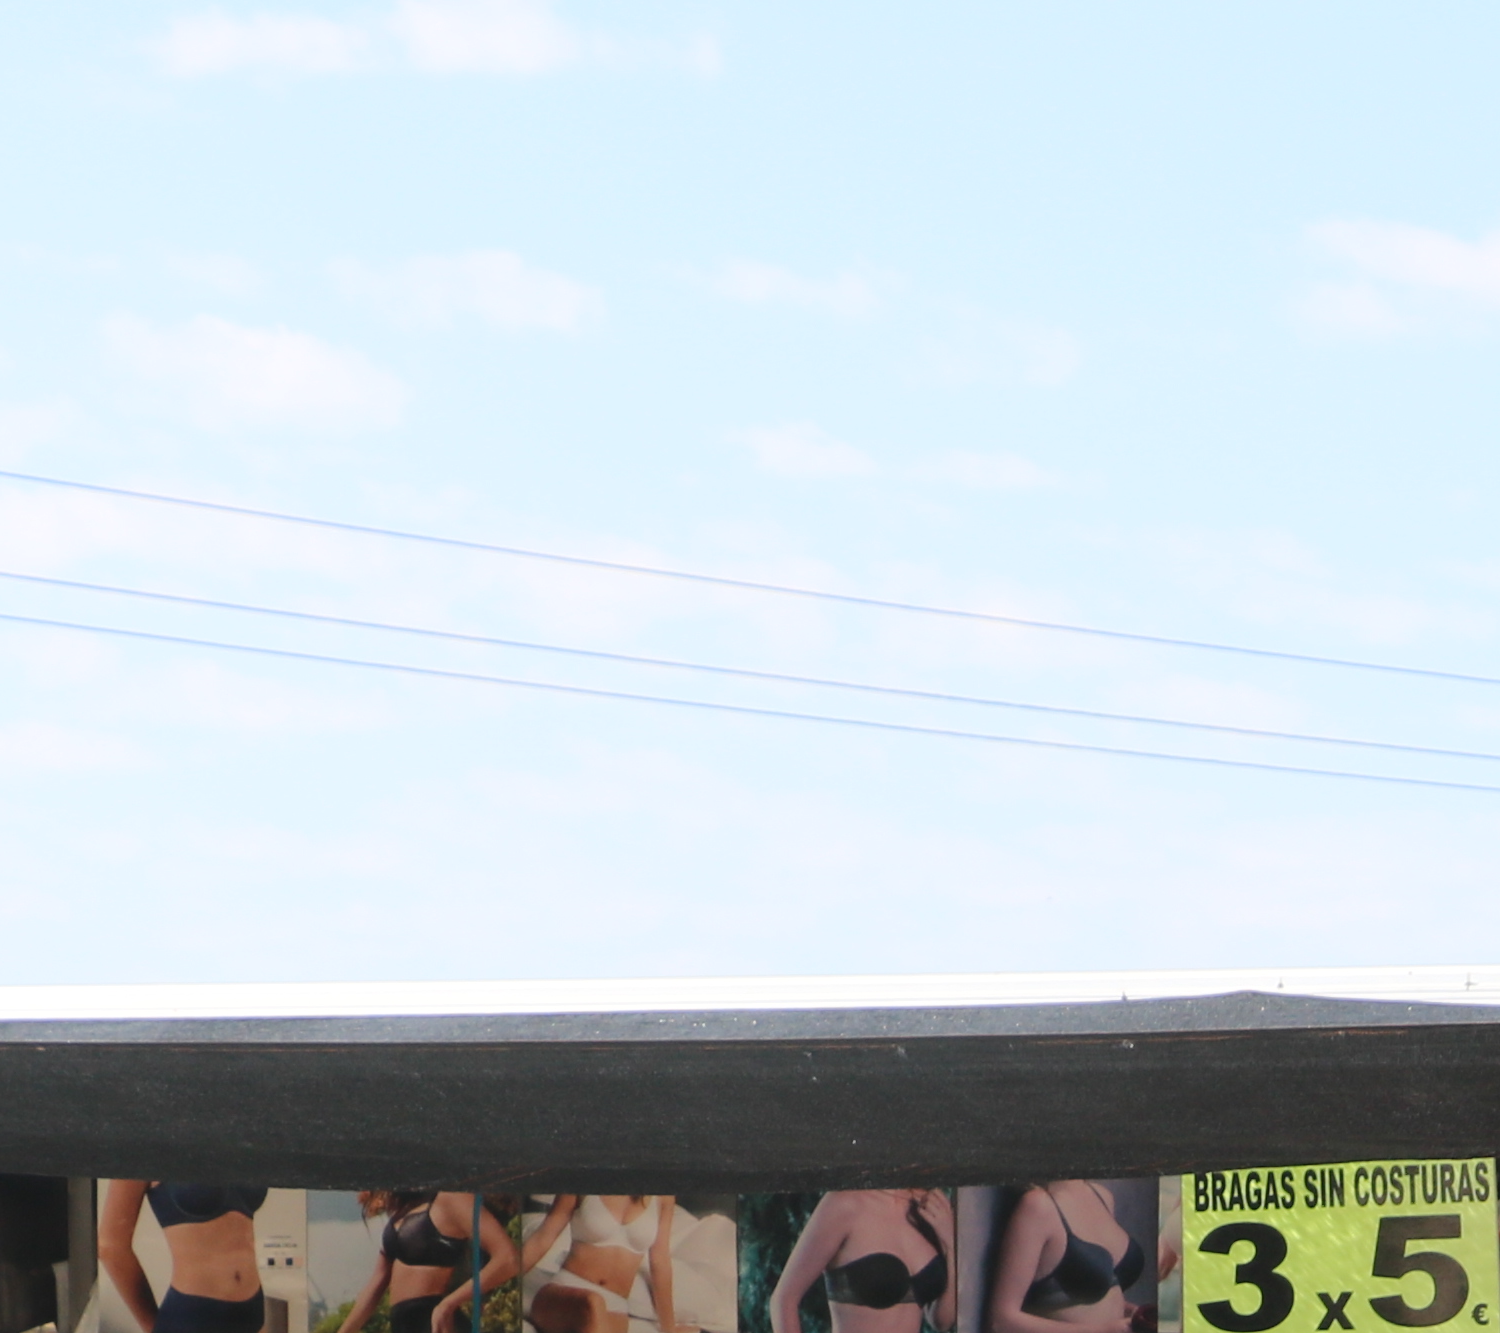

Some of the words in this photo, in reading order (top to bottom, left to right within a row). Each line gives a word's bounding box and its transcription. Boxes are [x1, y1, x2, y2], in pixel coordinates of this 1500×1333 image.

[1194, 1170, 1295, 1212] BRAGAS
[1304, 1167, 1345, 1208] SIN
[1354, 1161, 1490, 1206] COSTURAS
[1197, 1221, 1295, 1333] 3
